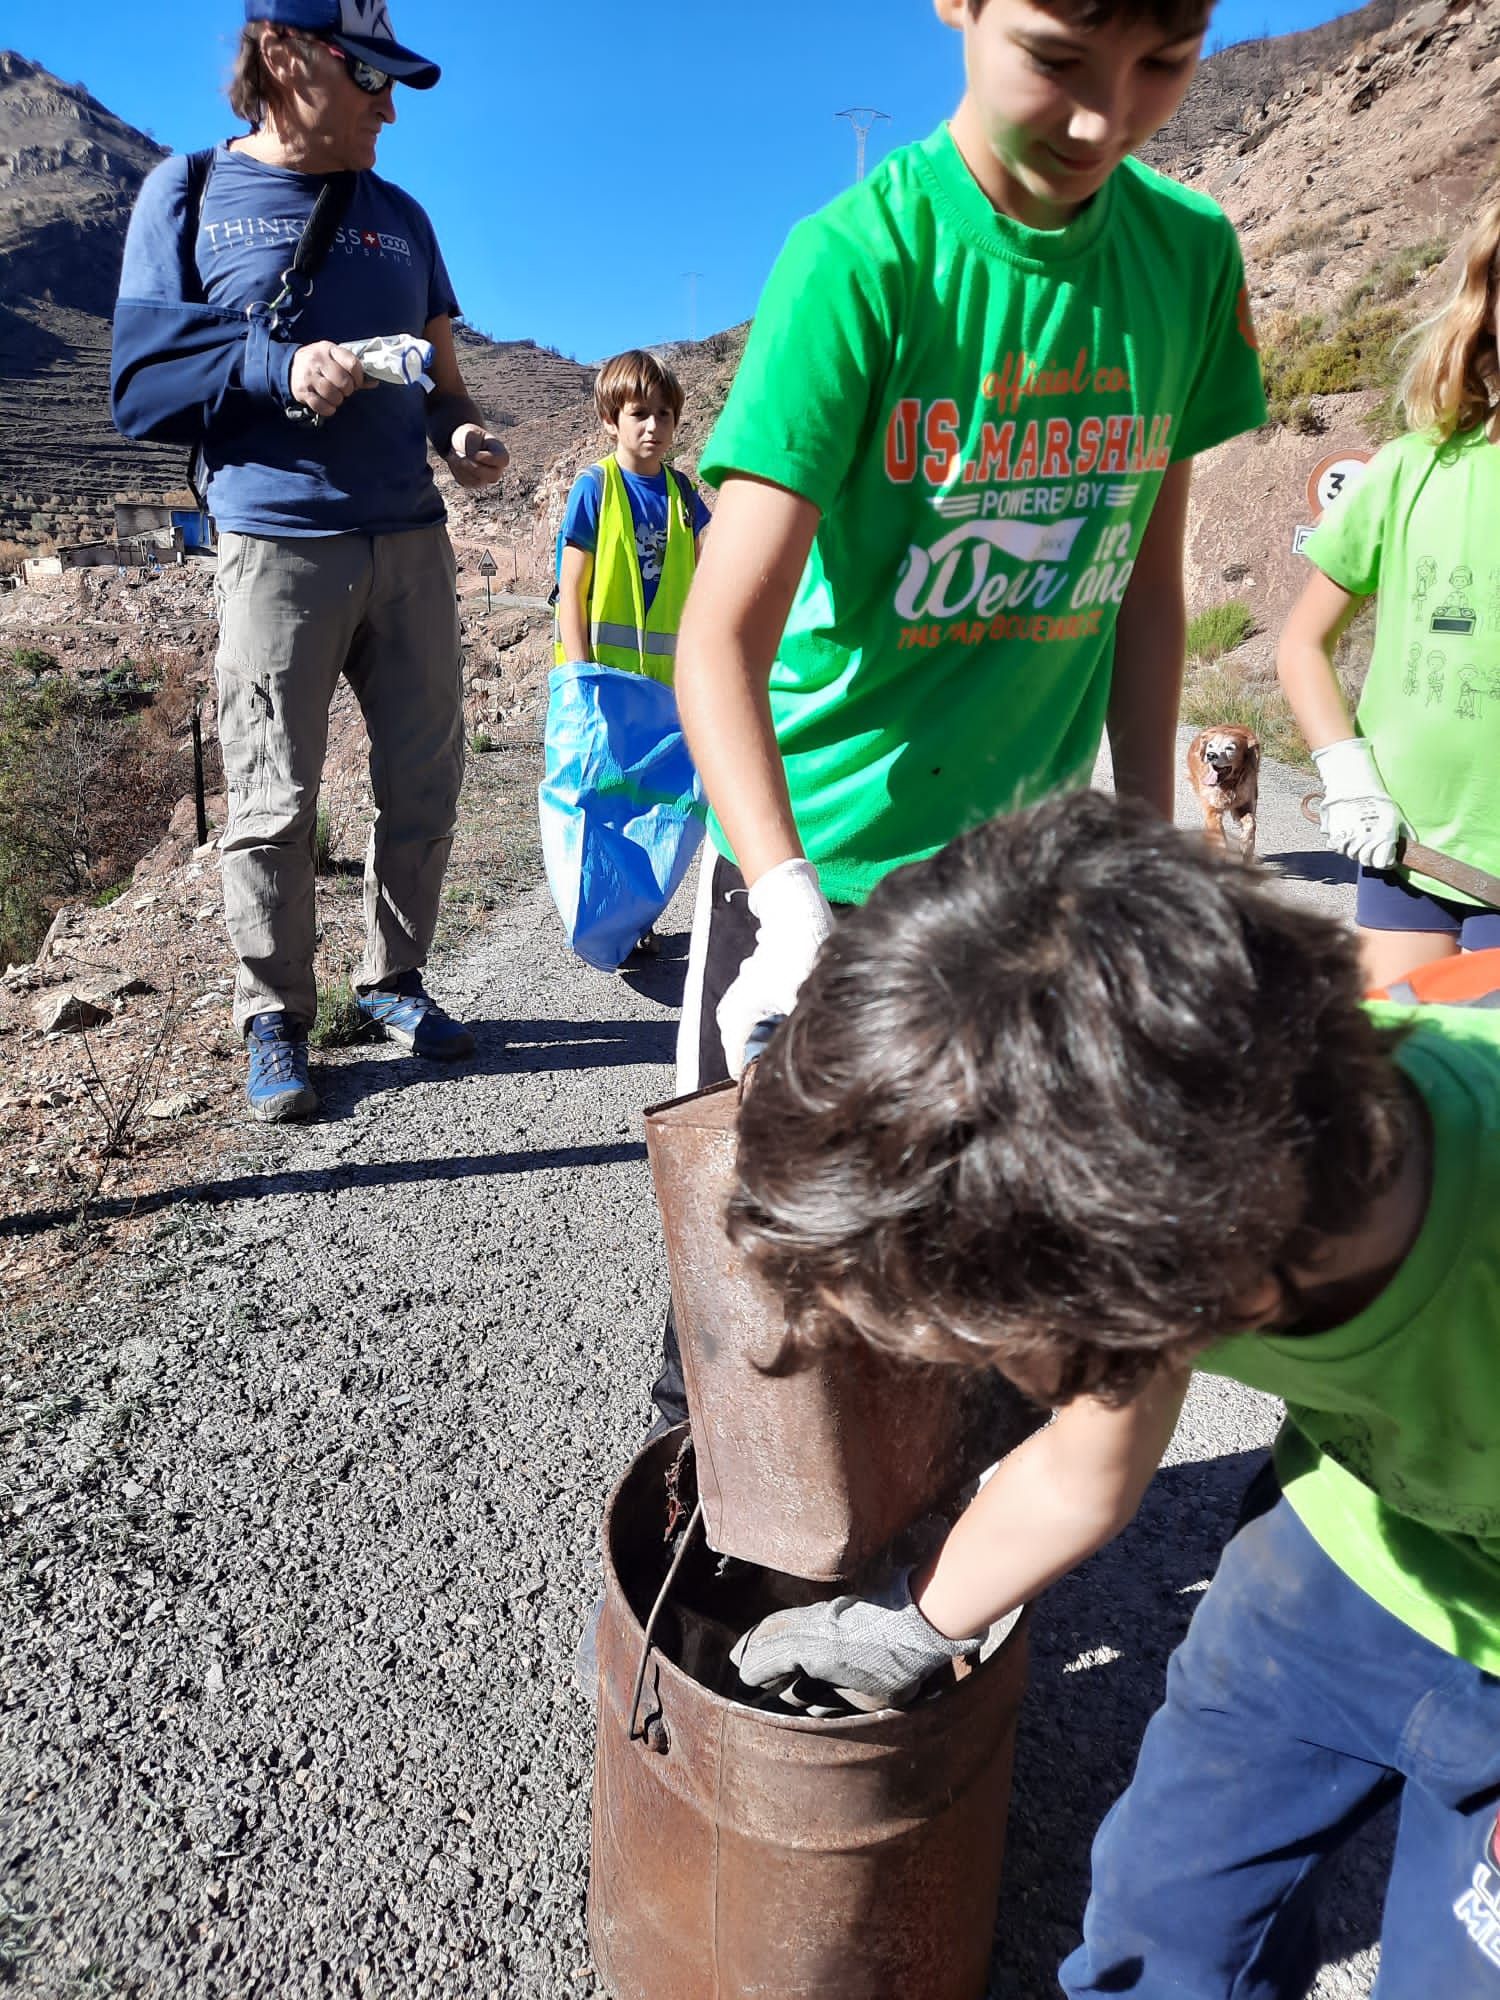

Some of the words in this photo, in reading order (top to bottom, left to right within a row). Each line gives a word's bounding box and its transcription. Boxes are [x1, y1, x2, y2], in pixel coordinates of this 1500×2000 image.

[982, 347, 1090, 416] official
[981, 486, 1073, 518] POWERED
[1073, 482, 1104, 509] BY
